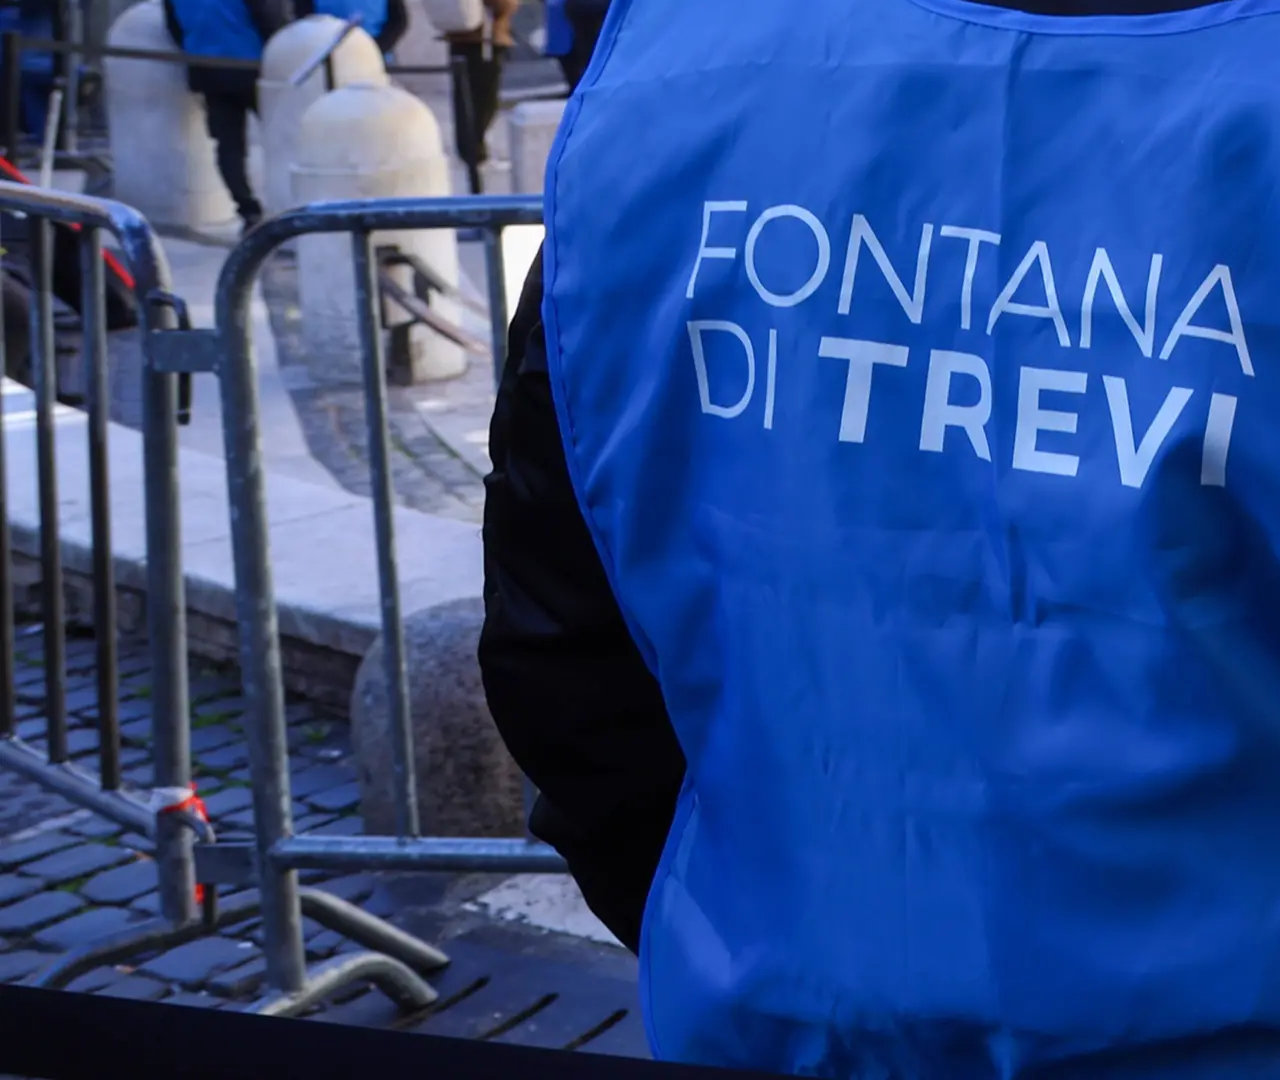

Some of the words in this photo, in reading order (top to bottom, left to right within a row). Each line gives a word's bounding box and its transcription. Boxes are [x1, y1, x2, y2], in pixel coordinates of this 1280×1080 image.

[685, 199, 1255, 377] FONTANA
[687, 319, 777, 430] DI
[819, 336, 1238, 489] TREVI
